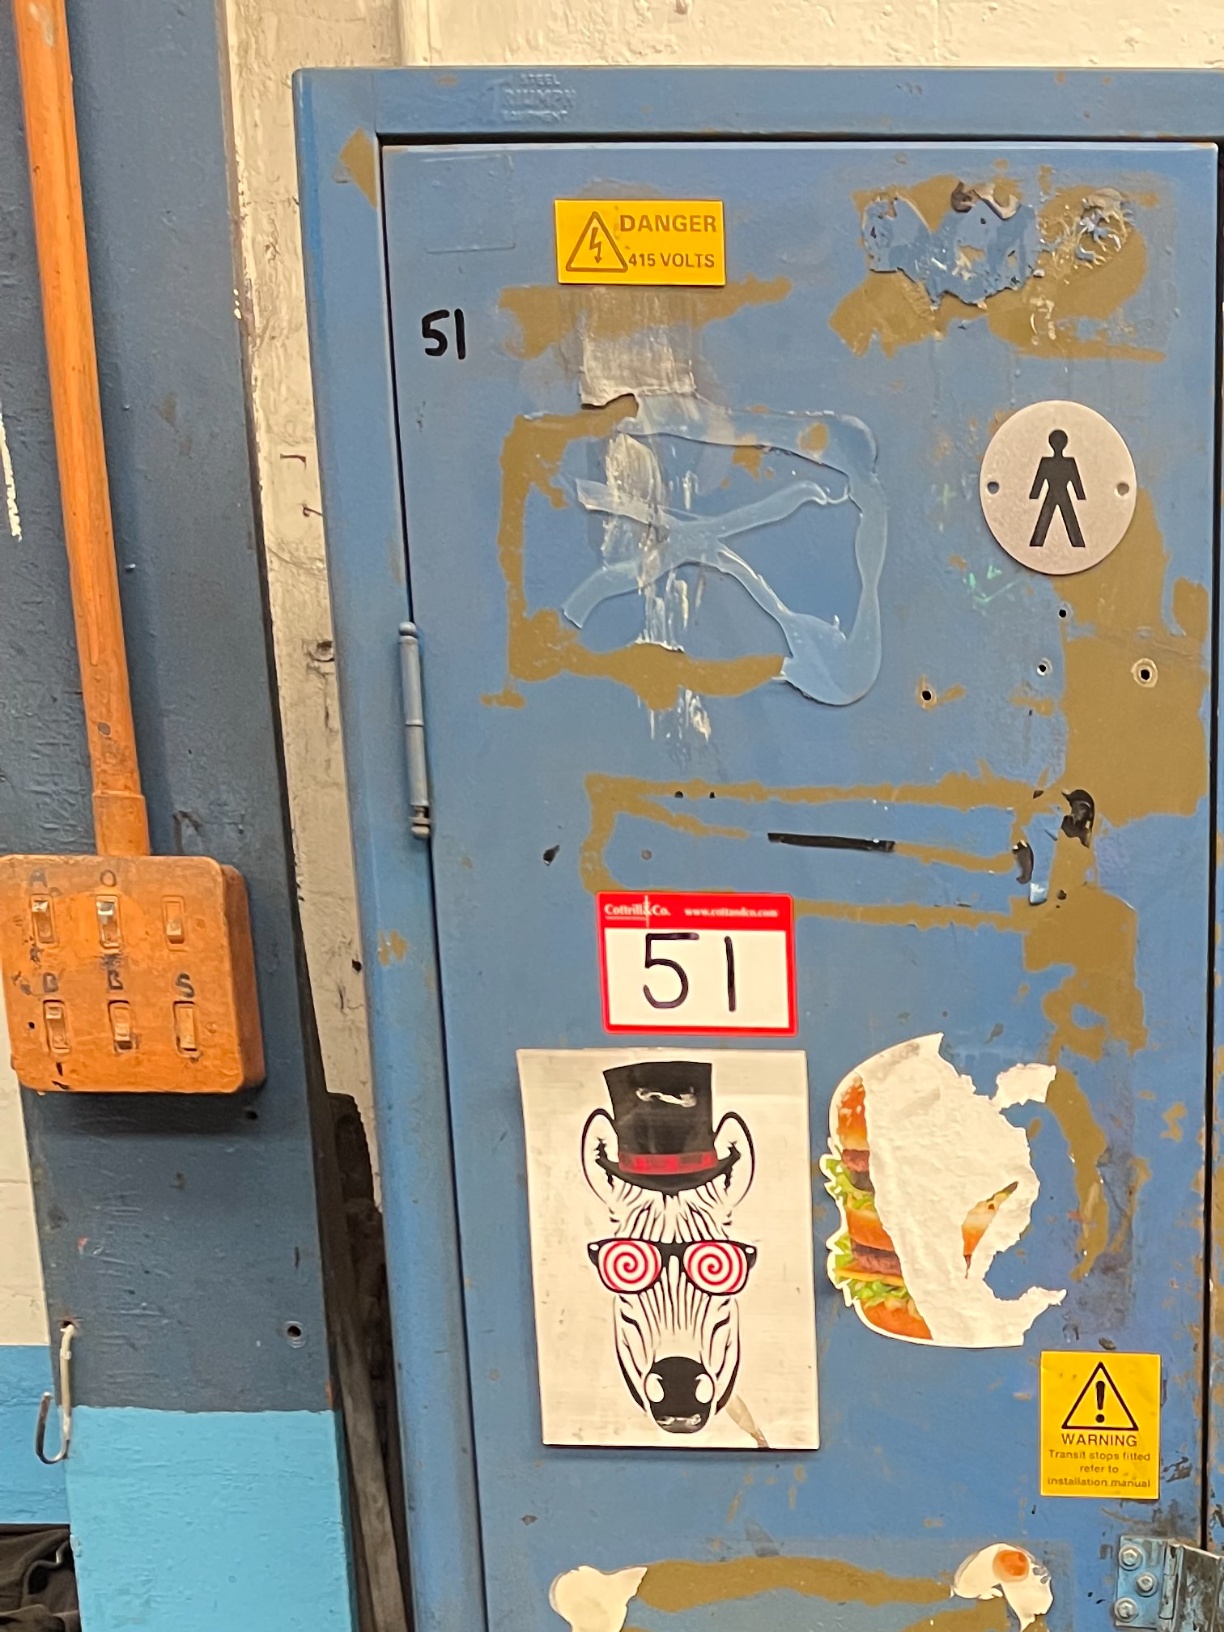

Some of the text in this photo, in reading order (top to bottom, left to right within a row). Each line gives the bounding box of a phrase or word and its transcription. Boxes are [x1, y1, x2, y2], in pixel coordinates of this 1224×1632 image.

[619, 214, 717, 233] DANGER
[628, 252, 715, 269] 415 VOLTS
[421, 308, 467, 360] 51
[642, 932, 738, 1012] 51
[1061, 1433, 1138, 1447] WARNING
[1049, 1449, 1151, 1462] Transit stops fitted
[1080, 1465, 1119, 1474] refer to
[1047, 1477, 1151, 1488] installation manual
